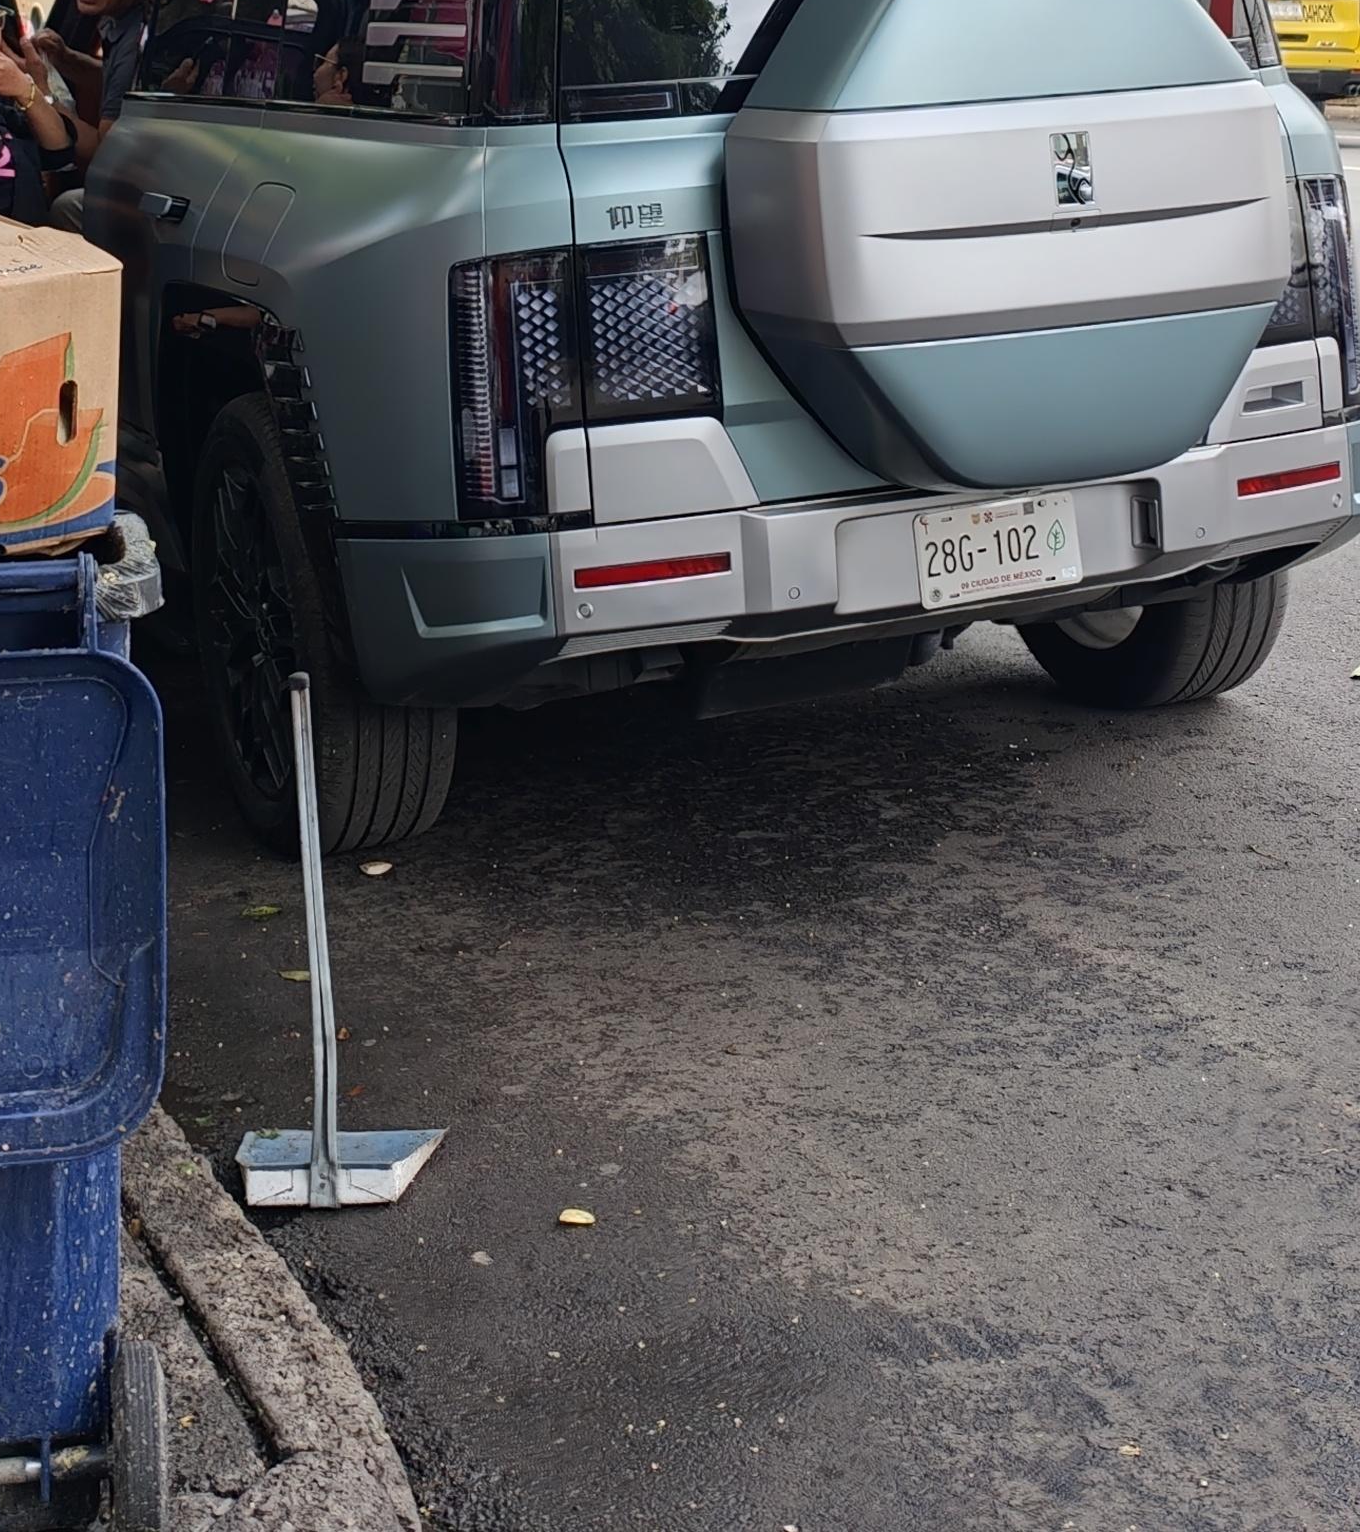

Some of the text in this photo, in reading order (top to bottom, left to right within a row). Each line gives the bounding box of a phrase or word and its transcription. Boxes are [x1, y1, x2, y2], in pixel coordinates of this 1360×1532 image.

[605, 202, 664, 231] 仰望
[924, 524, 1040, 579] 28G-102
[970, 576, 1000, 588] CIUDAD
[1000, 573, 1012, 583] DE
